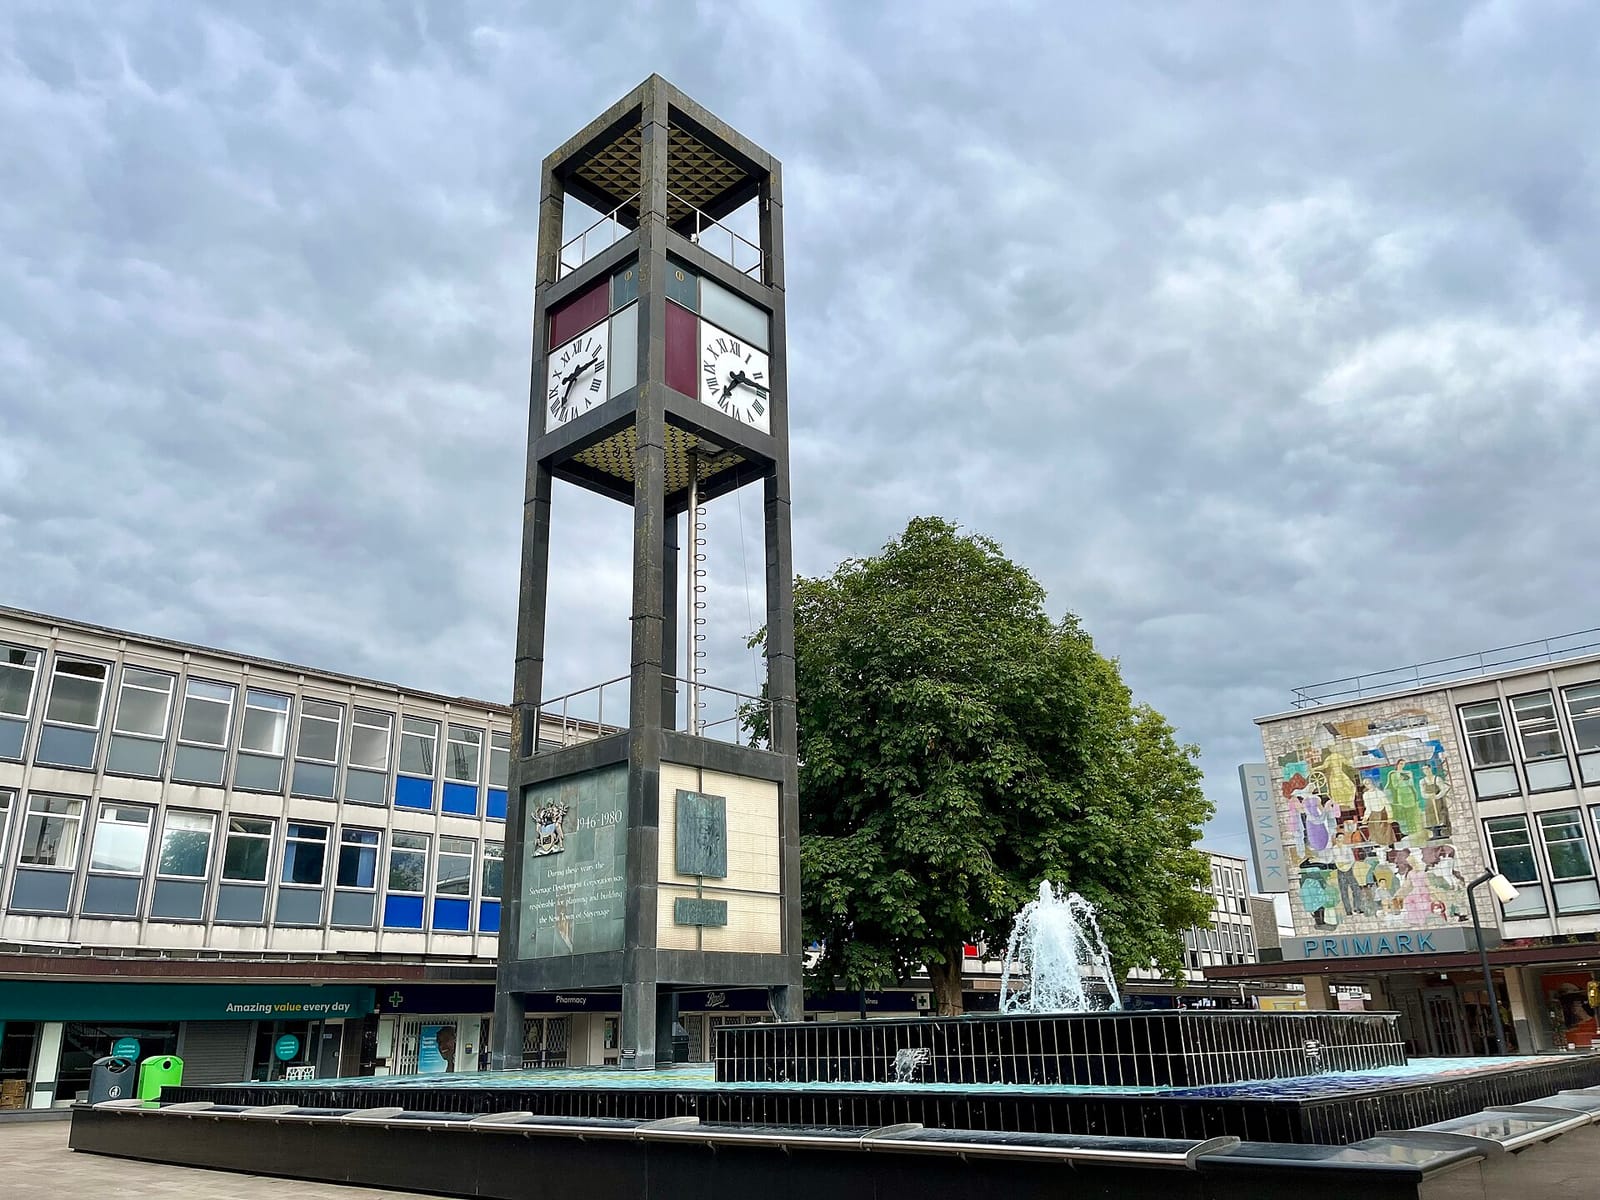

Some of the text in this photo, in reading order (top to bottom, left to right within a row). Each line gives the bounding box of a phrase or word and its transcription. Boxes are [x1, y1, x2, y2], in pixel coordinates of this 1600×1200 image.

[706, 344, 719, 361] X
[716, 338, 728, 354] XI
[729, 339, 741, 358] XII
[561, 351, 571, 367] XI
[744, 353, 752, 365] I
[552, 370, 562, 379] X
[577, 809, 623, 831] 1946-1980
[1251, 775, 1282, 878] PRIMARK
[1304, 932, 1436, 957] PRIMARK
[555, 994, 587, 1005] Pharmacy
[225, 1002, 350, 1014] Amazing value every day
